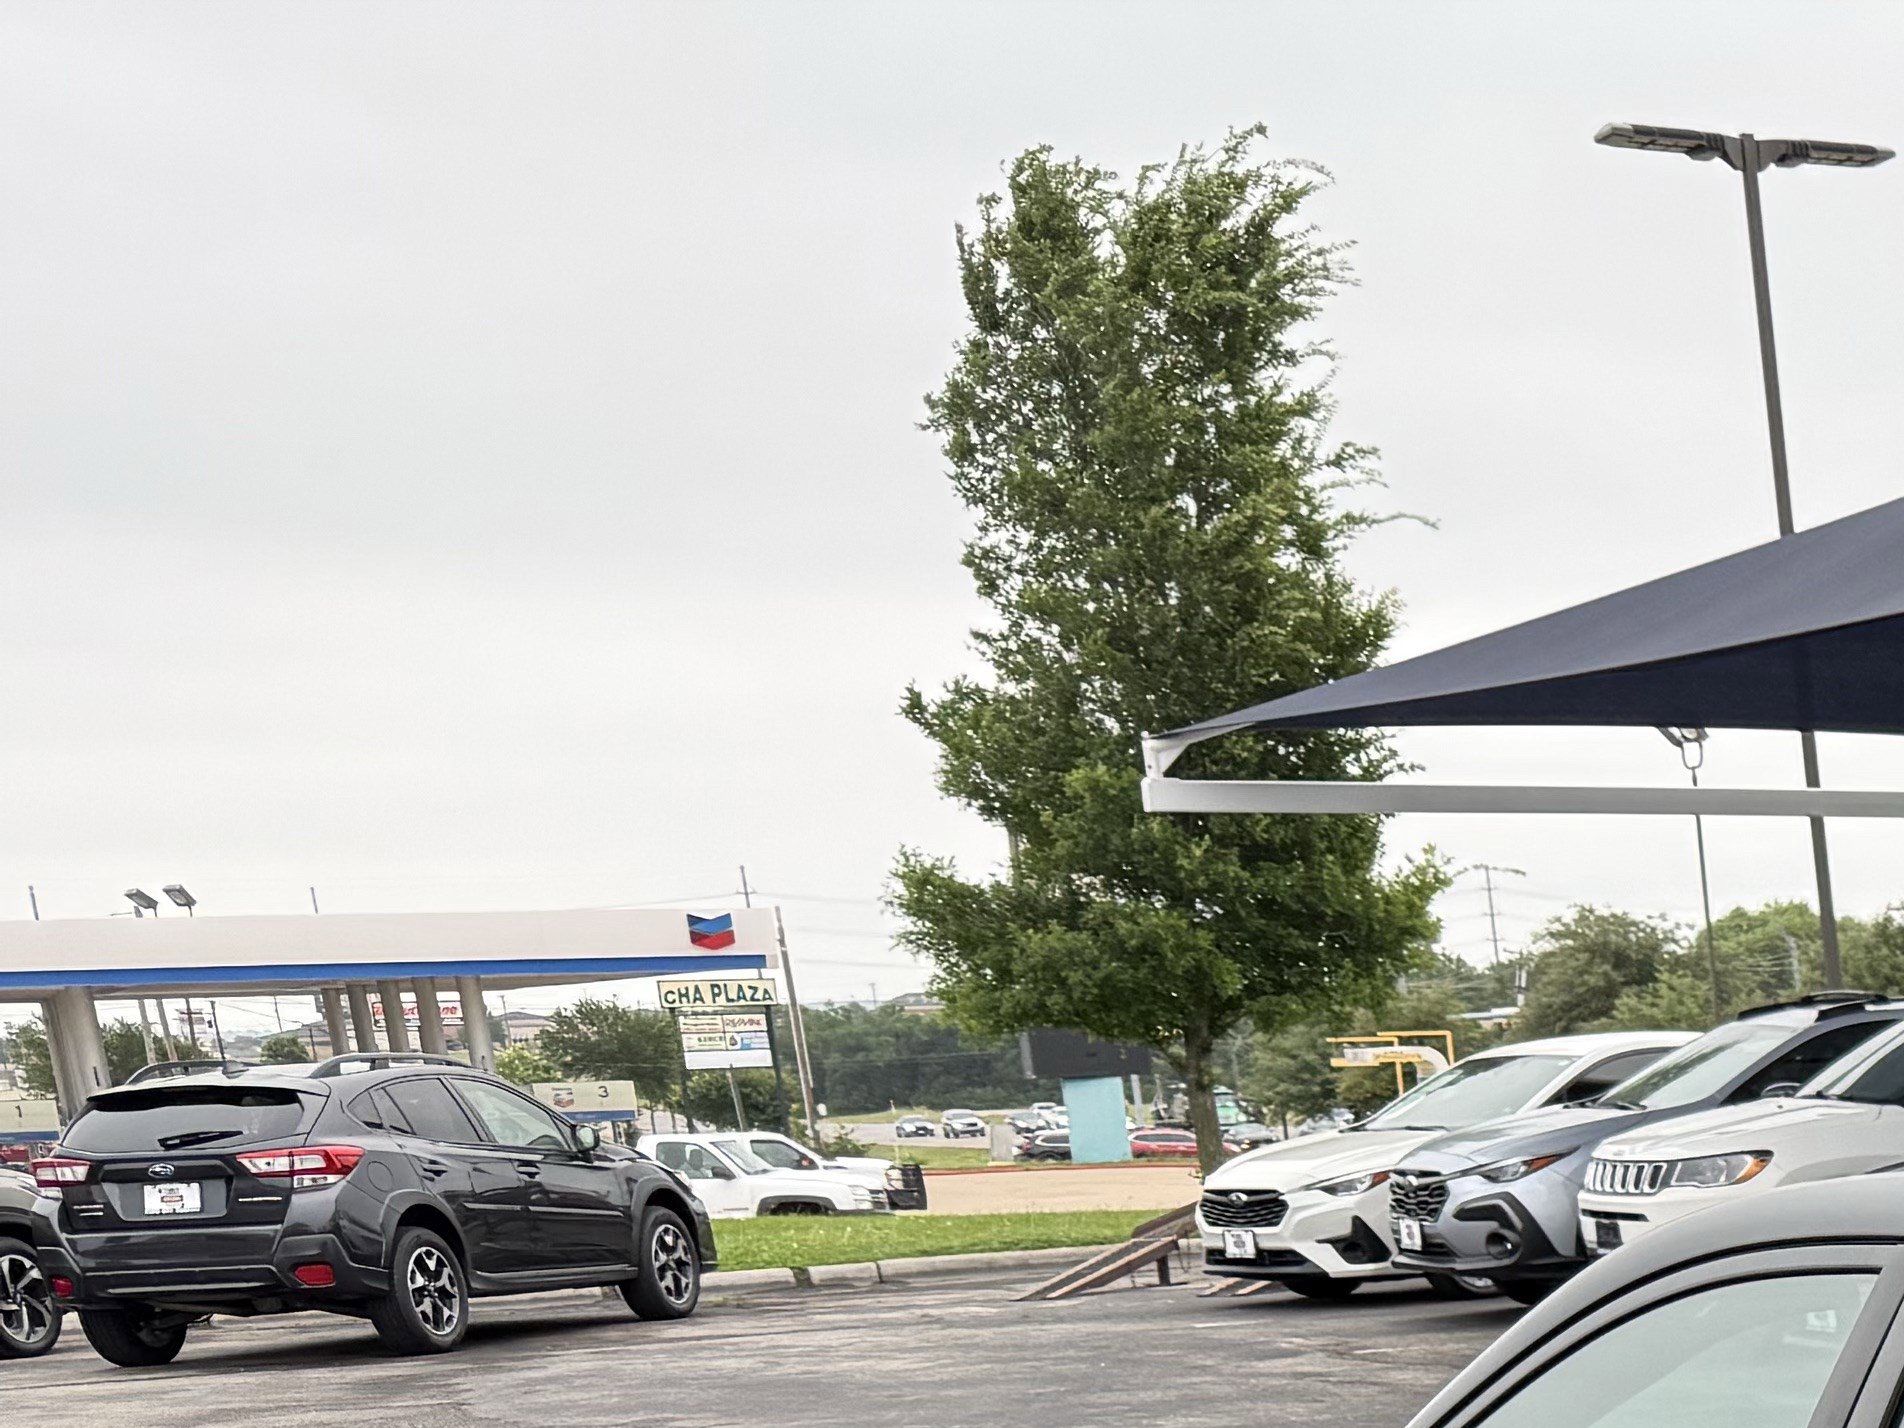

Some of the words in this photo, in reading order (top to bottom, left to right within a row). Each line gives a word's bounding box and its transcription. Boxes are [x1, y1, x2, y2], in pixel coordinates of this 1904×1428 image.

[663, 984, 705, 1005] CHA
[710, 983, 774, 1004] PLAZA
[597, 1085, 609, 1098] 3
[15, 1105, 23, 1118] 1
